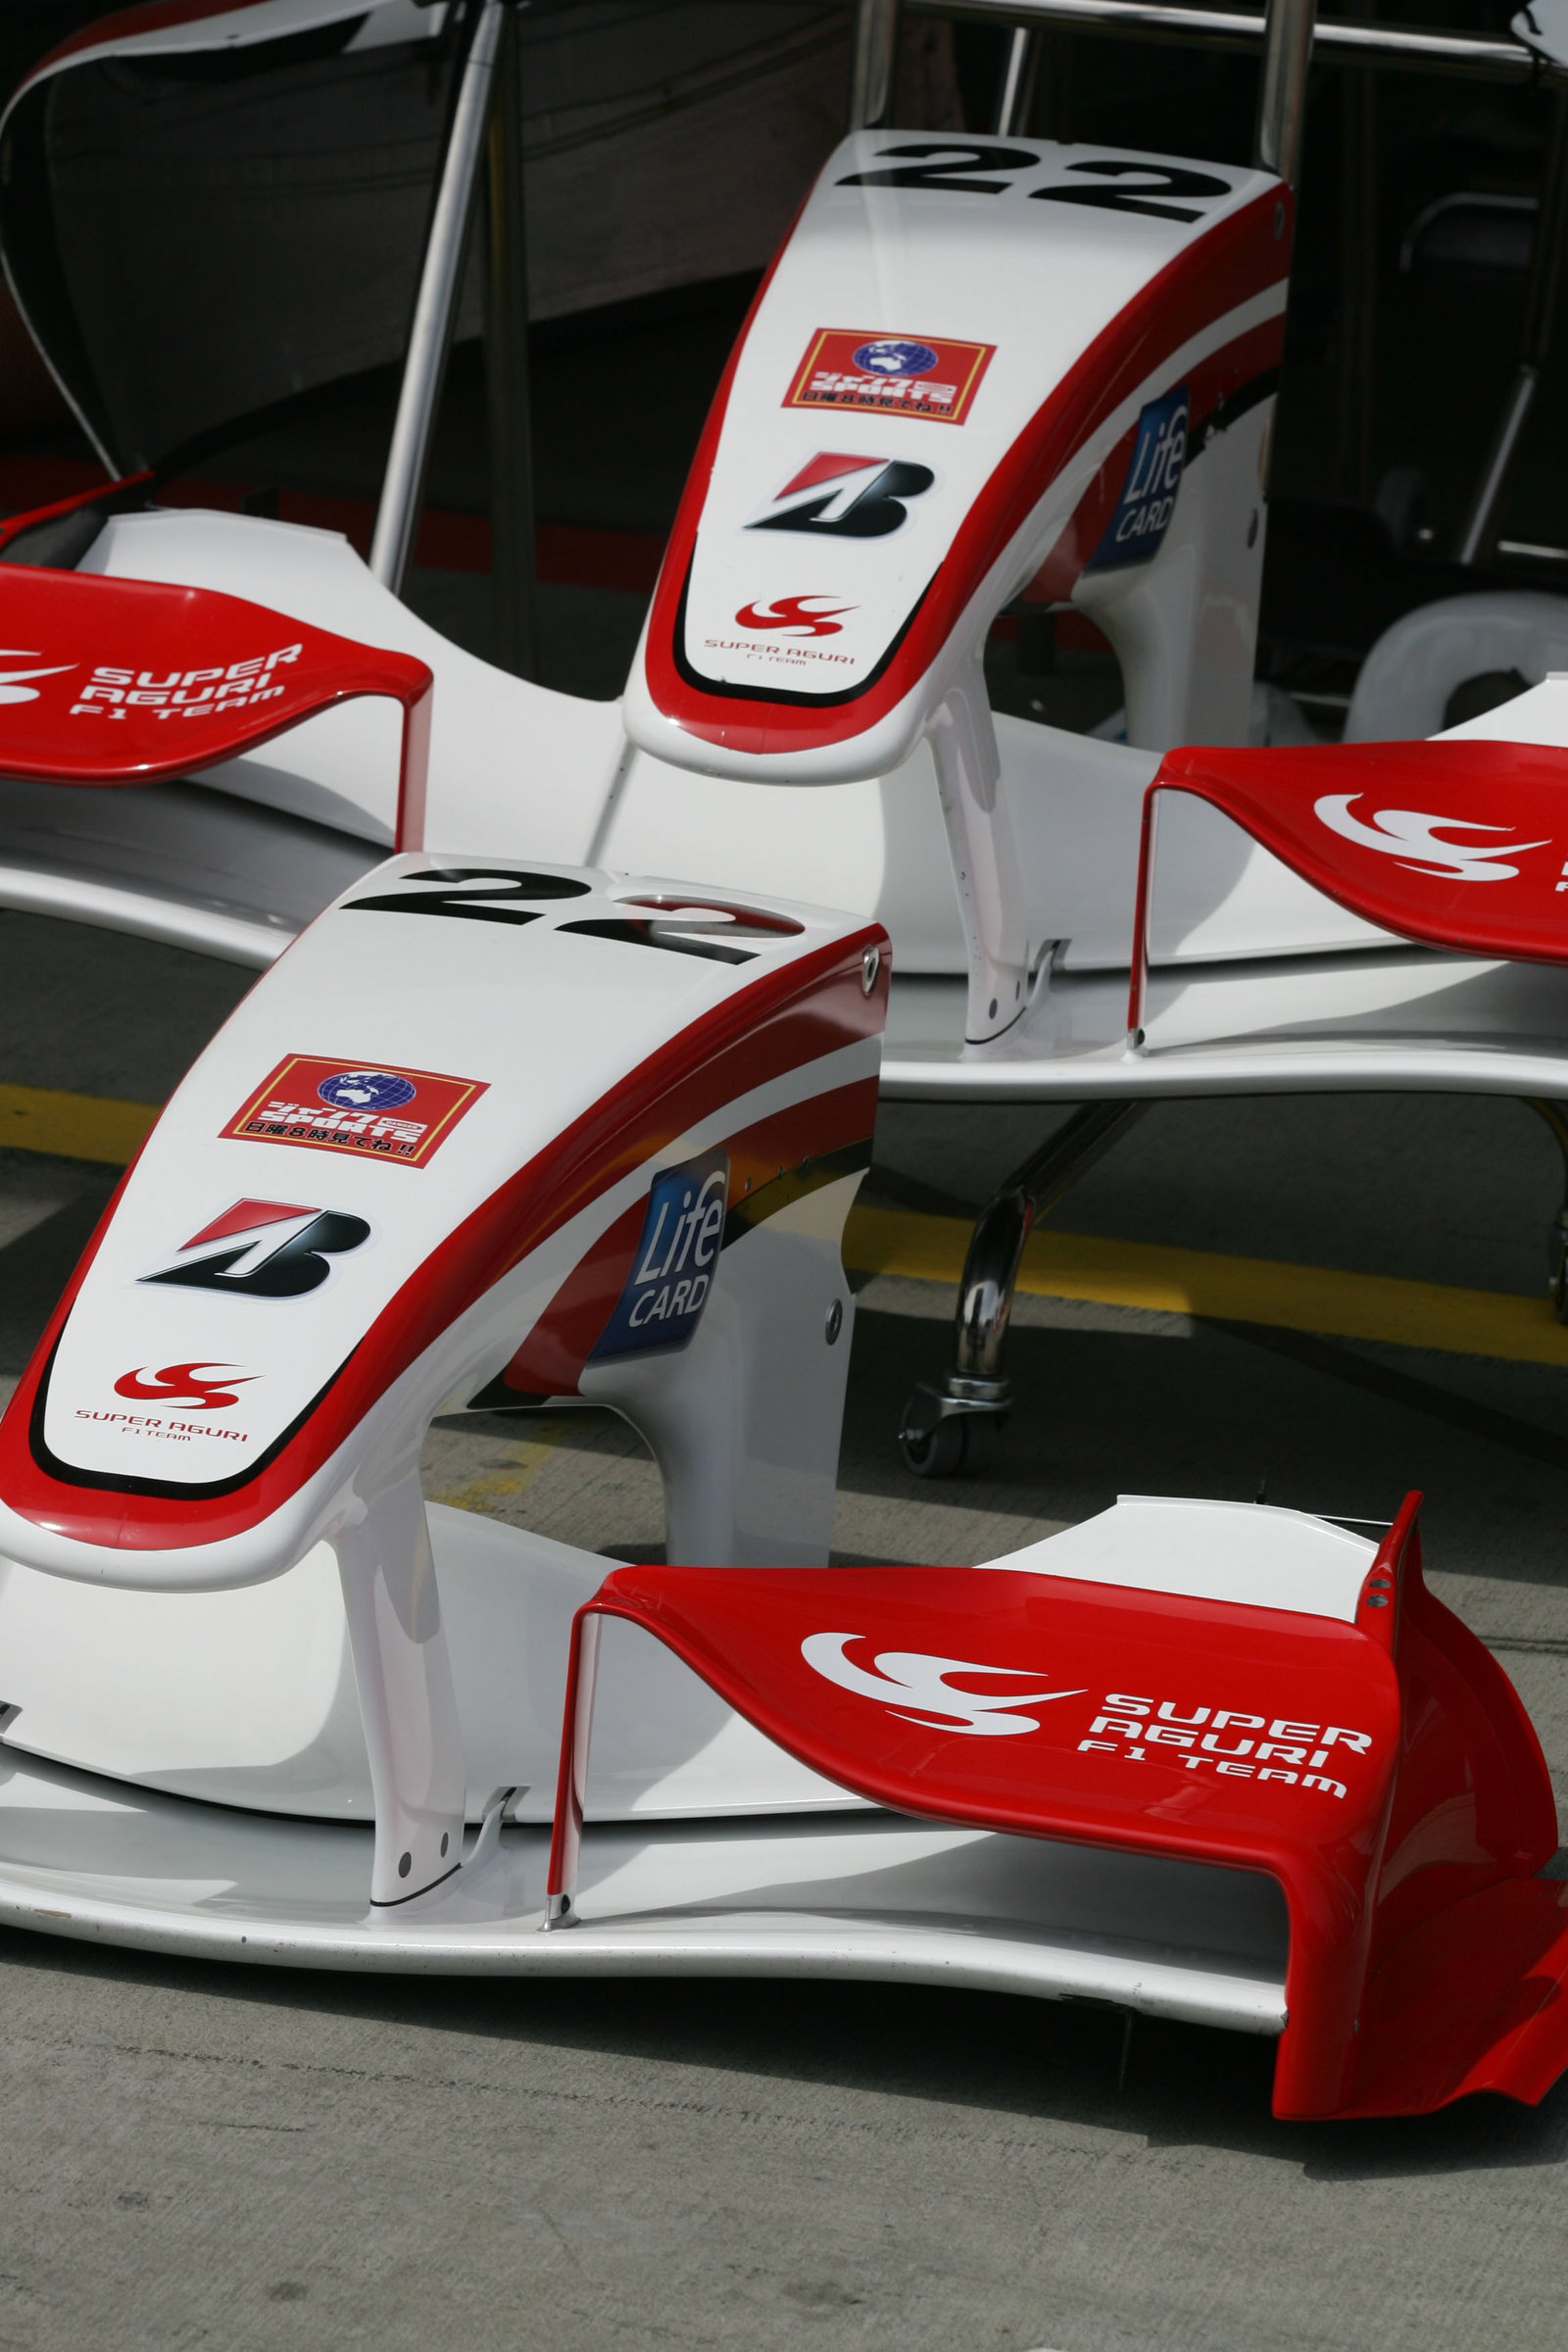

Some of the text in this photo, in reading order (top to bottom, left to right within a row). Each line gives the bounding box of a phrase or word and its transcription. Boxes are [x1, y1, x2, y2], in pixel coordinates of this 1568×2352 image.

[835, 144, 1232, 223] 22
[1123, 405, 1188, 505] Life
[1115, 496, 1173, 542] CARD
[91, 643, 303, 688] SUPER
[705, 639, 855, 665] SUPER AGURI
[70, 685, 285, 719] F1 TEAM
[79, 672, 270, 706] AGURI
[339, 868, 806, 965] 22
[258, 1110, 424, 1144] SPORTS
[635, 1170, 725, 1286] Life
[629, 1274, 709, 1327] CARD
[74, 1409, 248, 1442] SUPER AGURI
[122, 1426, 191, 1441] F1 TEAM
[1089, 1715, 1329, 1768] AGURI
[1102, 1692, 1372, 1755] SUPER
[1077, 1739, 1348, 1799] F1 TEAM
